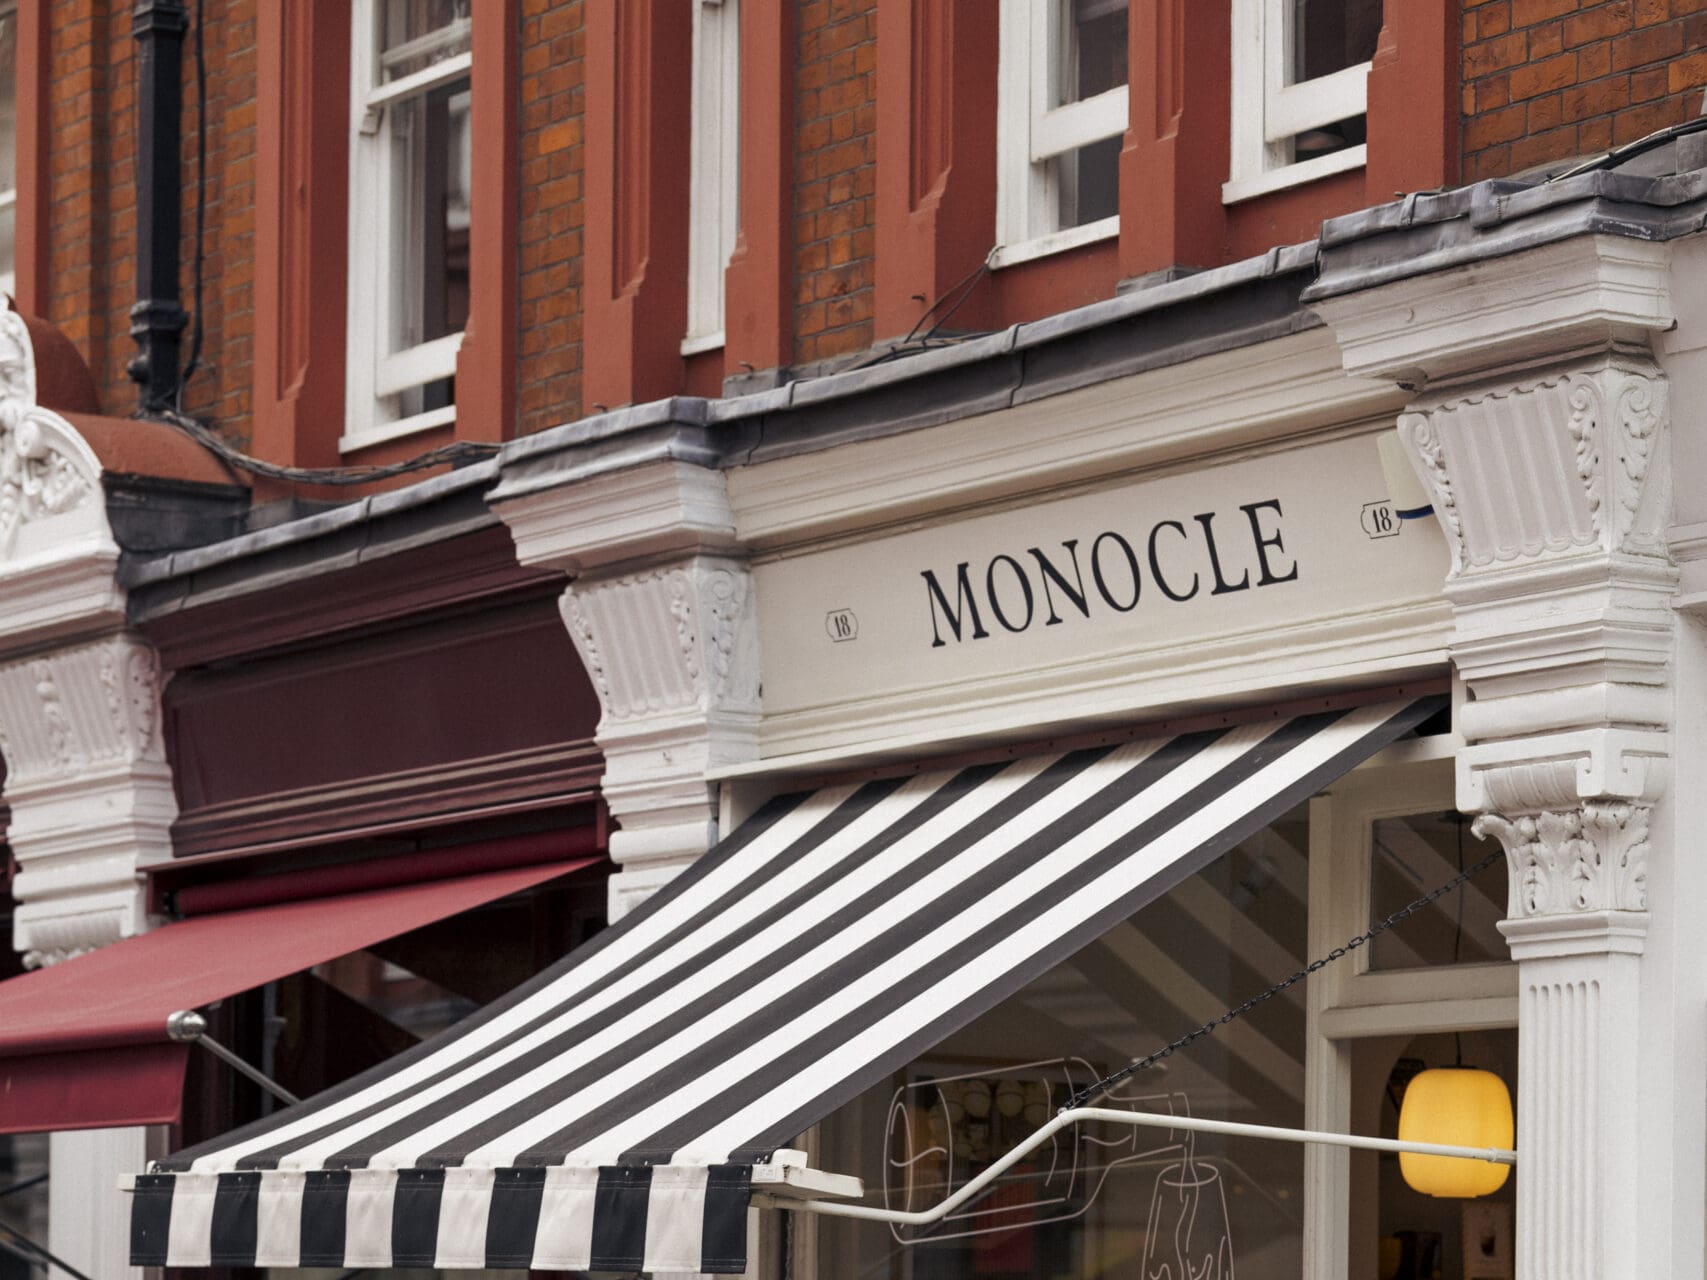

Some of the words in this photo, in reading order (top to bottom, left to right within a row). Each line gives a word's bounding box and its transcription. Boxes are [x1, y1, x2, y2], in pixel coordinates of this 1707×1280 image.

[1372, 506, 1392, 533] 18
[921, 498, 1298, 648] MONOCLE
[834, 614, 851, 637] 18
